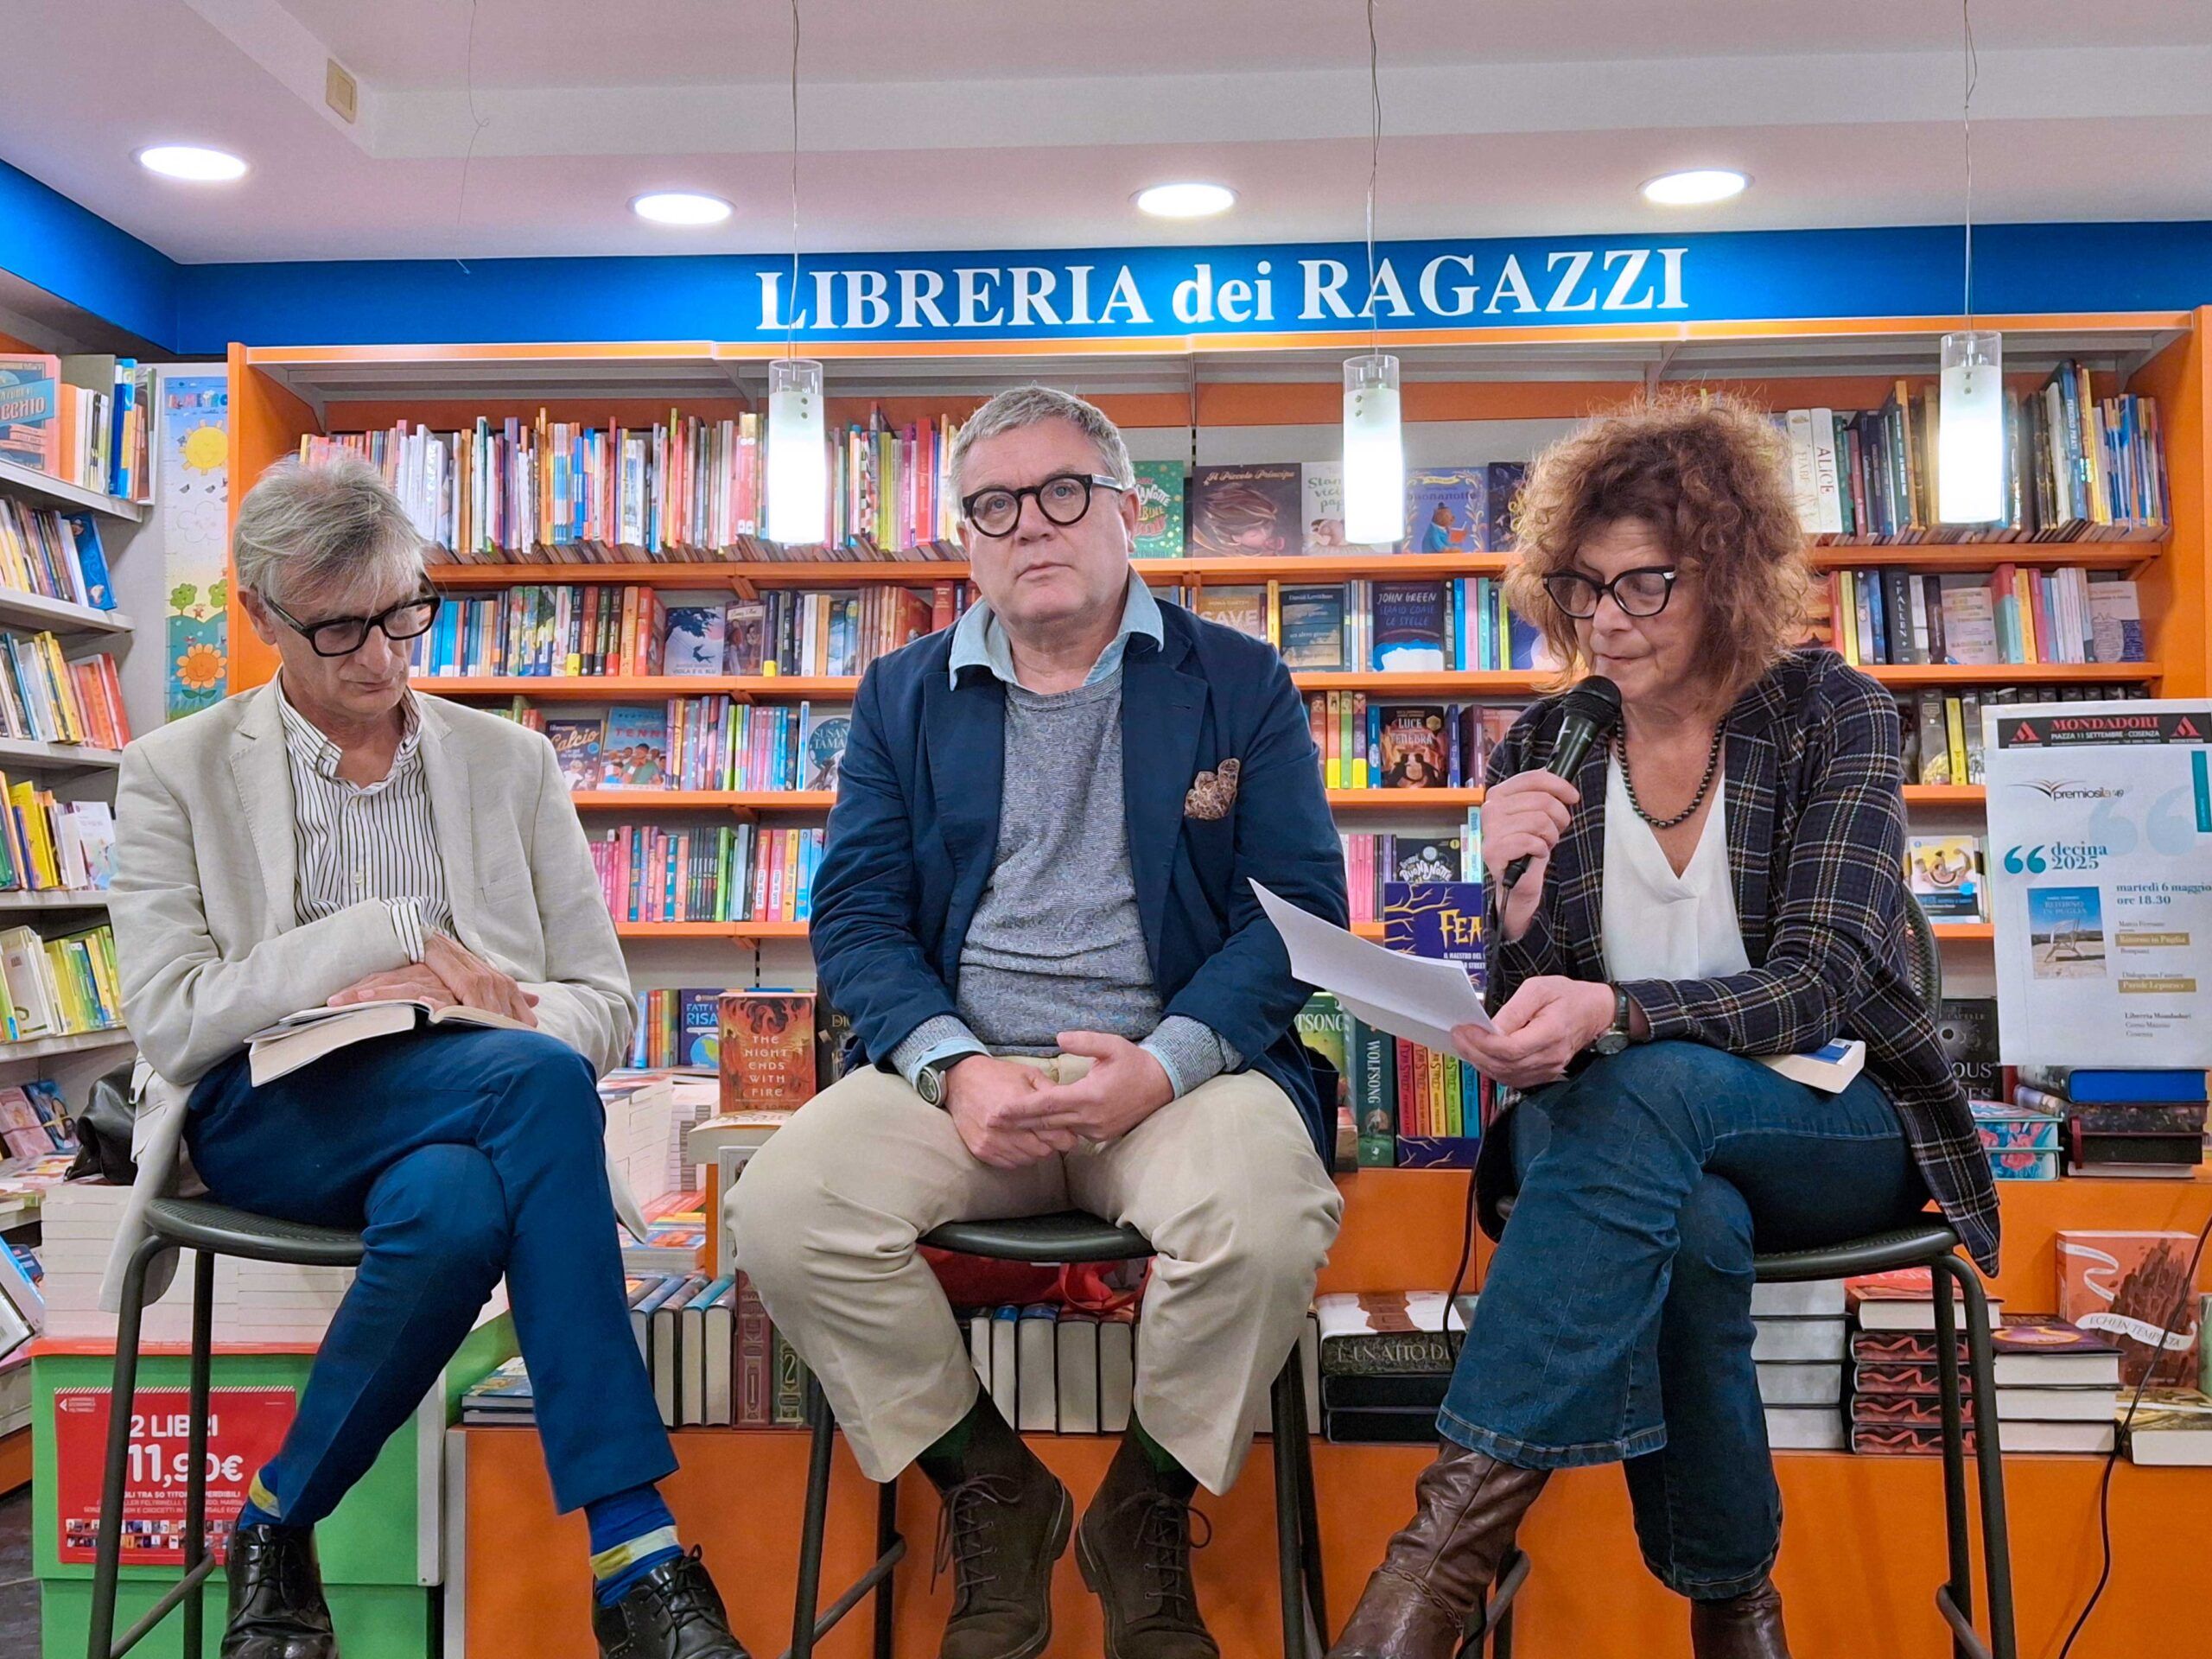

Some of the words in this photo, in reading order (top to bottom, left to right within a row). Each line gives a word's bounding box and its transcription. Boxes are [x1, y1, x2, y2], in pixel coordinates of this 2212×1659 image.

[755, 264, 1154, 330] LIBRERIA
[1172, 261, 1274, 324] dei
[1298, 248, 1688, 321] RAGAZZI
[0, 397, 45, 421] CCHIO
[1816, 446, 1834, 495] ALICE
[1376, 592, 1403, 605] JOHN
[1405, 591, 1437, 602] GREEN
[1896, 587, 1907, 637] FALLEN
[1398, 718, 1422, 729] LUCE
[2050, 717, 2158, 731] MONDADORI
[616, 728, 666, 739] TENNI
[815, 728, 849, 738] SUSAN
[2085, 731, 2124, 740] SETTEMBRE
[551, 729, 599, 752] Calcio
[815, 738, 846, 749] TAMA
[2050, 841, 2107, 855] decina
[2051, 855, 2100, 870] 2025
[2116, 881, 2159, 892] martedì
[2161, 881, 2169, 892] 6
[2171, 881, 2212, 894] maggio
[2117, 897, 2135, 906] ore
[2139, 895, 2171, 906] 18.30
[1438, 908, 1482, 950] FEA
[686, 1003, 714, 1013] FATTI
[686, 1013, 719, 1026] RISA
[752, 1035, 779, 1044] THE
[744, 1048, 789, 1057] NIGHT
[748, 1062, 785, 1071] ENDS
[1367, 1039, 1382, 1104] WOLFSONG
[749, 1075, 785, 1084] WITH
[751, 1088, 784, 1097] FIRE
[130, 1414, 144, 1437] 2
[129, 1444, 243, 1488] 11,90€
